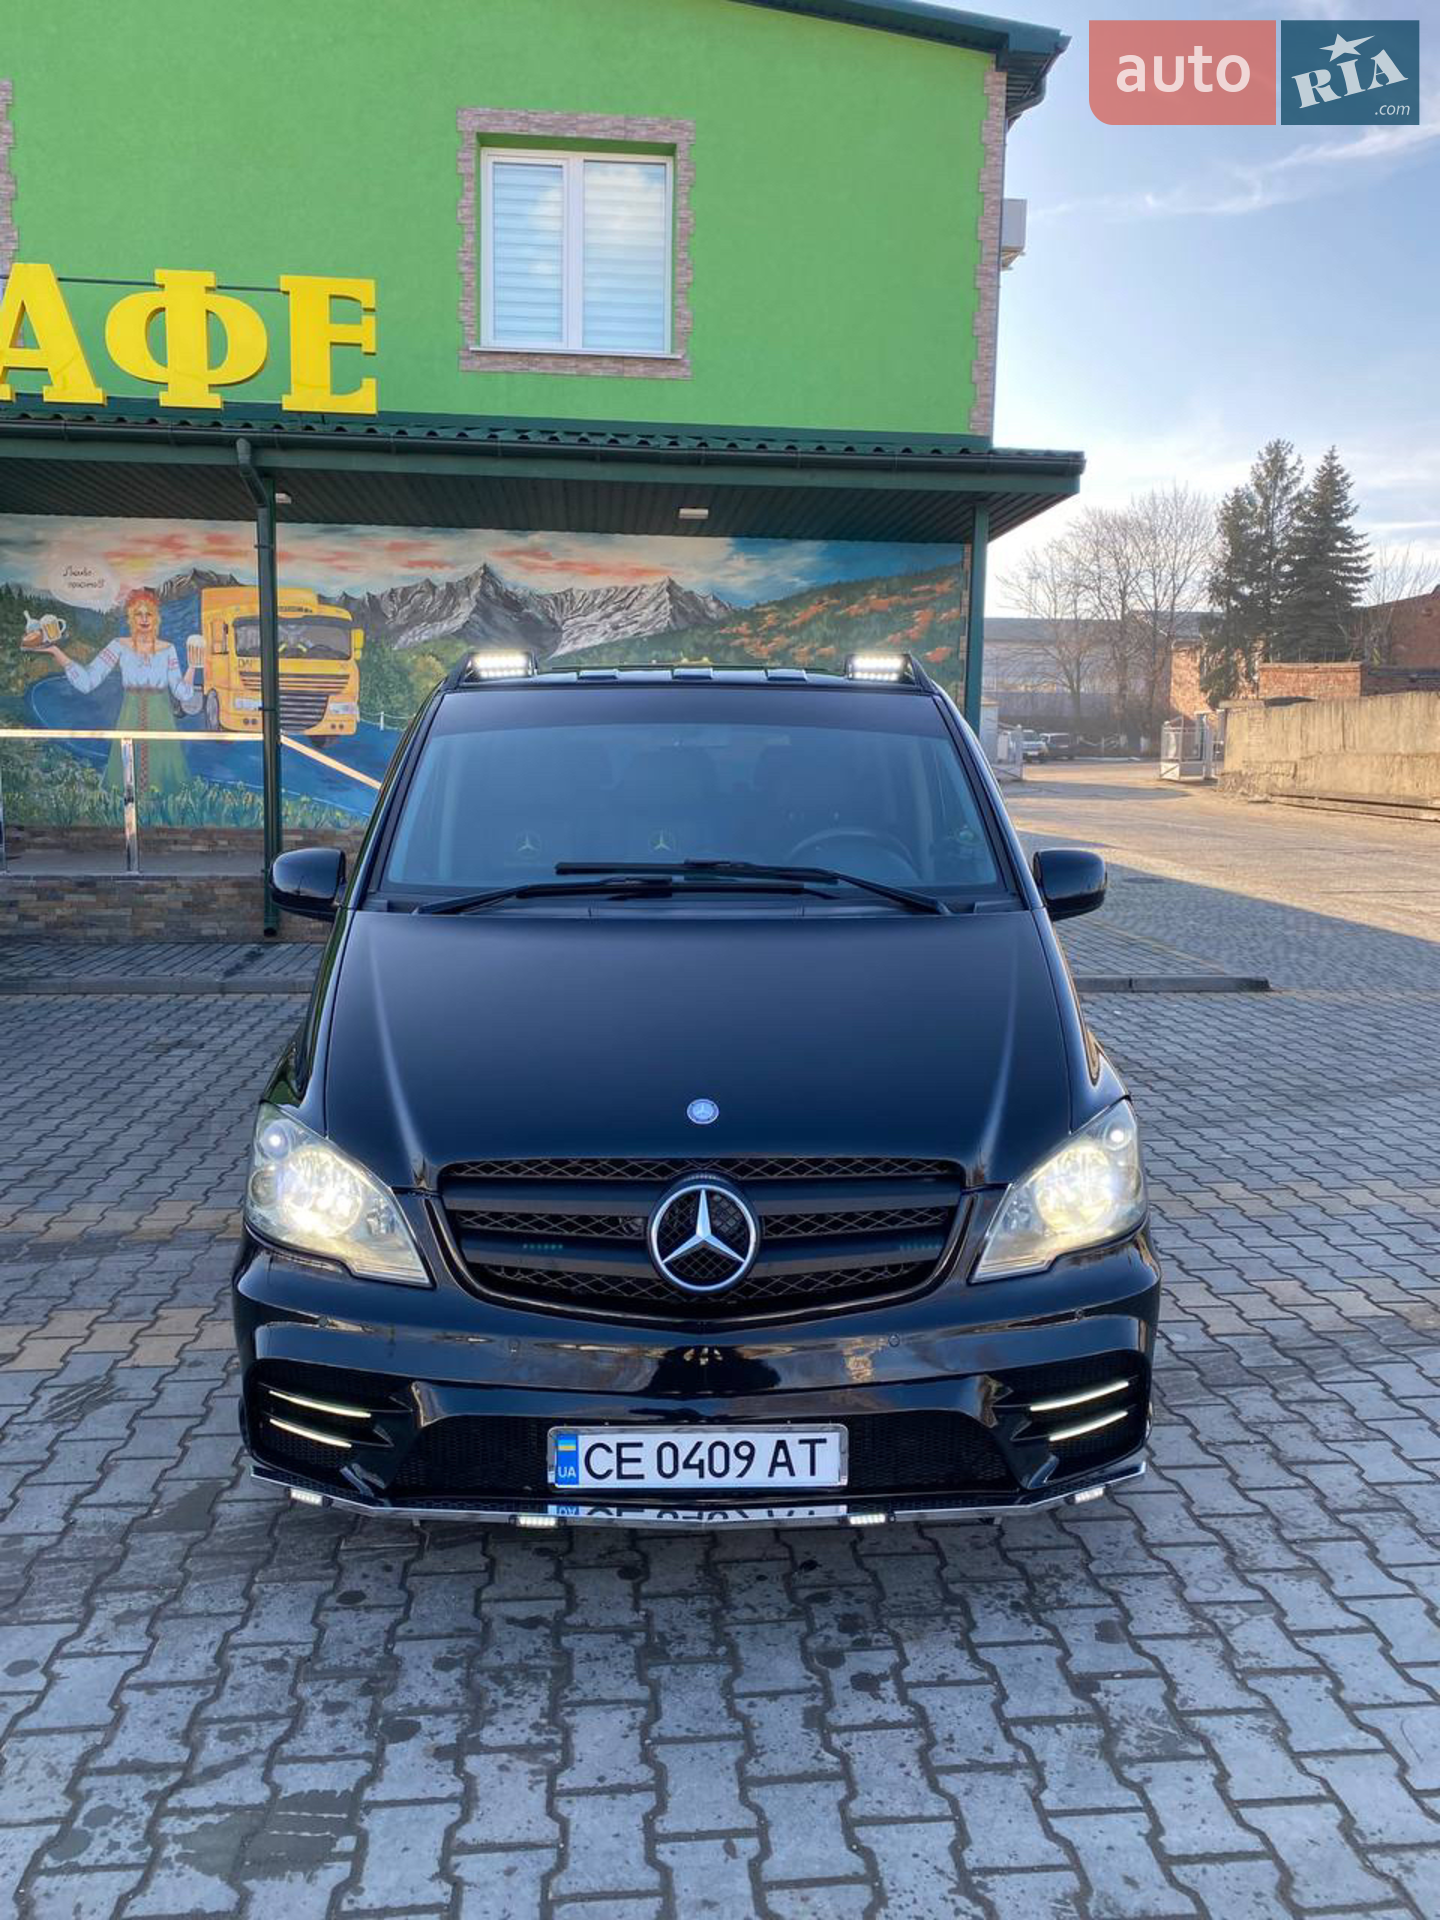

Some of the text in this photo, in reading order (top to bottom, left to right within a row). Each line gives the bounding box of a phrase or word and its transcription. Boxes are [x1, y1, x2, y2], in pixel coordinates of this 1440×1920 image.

[557, 1466, 577, 1479] UA
[584, 1437, 827, 1480] CE 0409 AT
